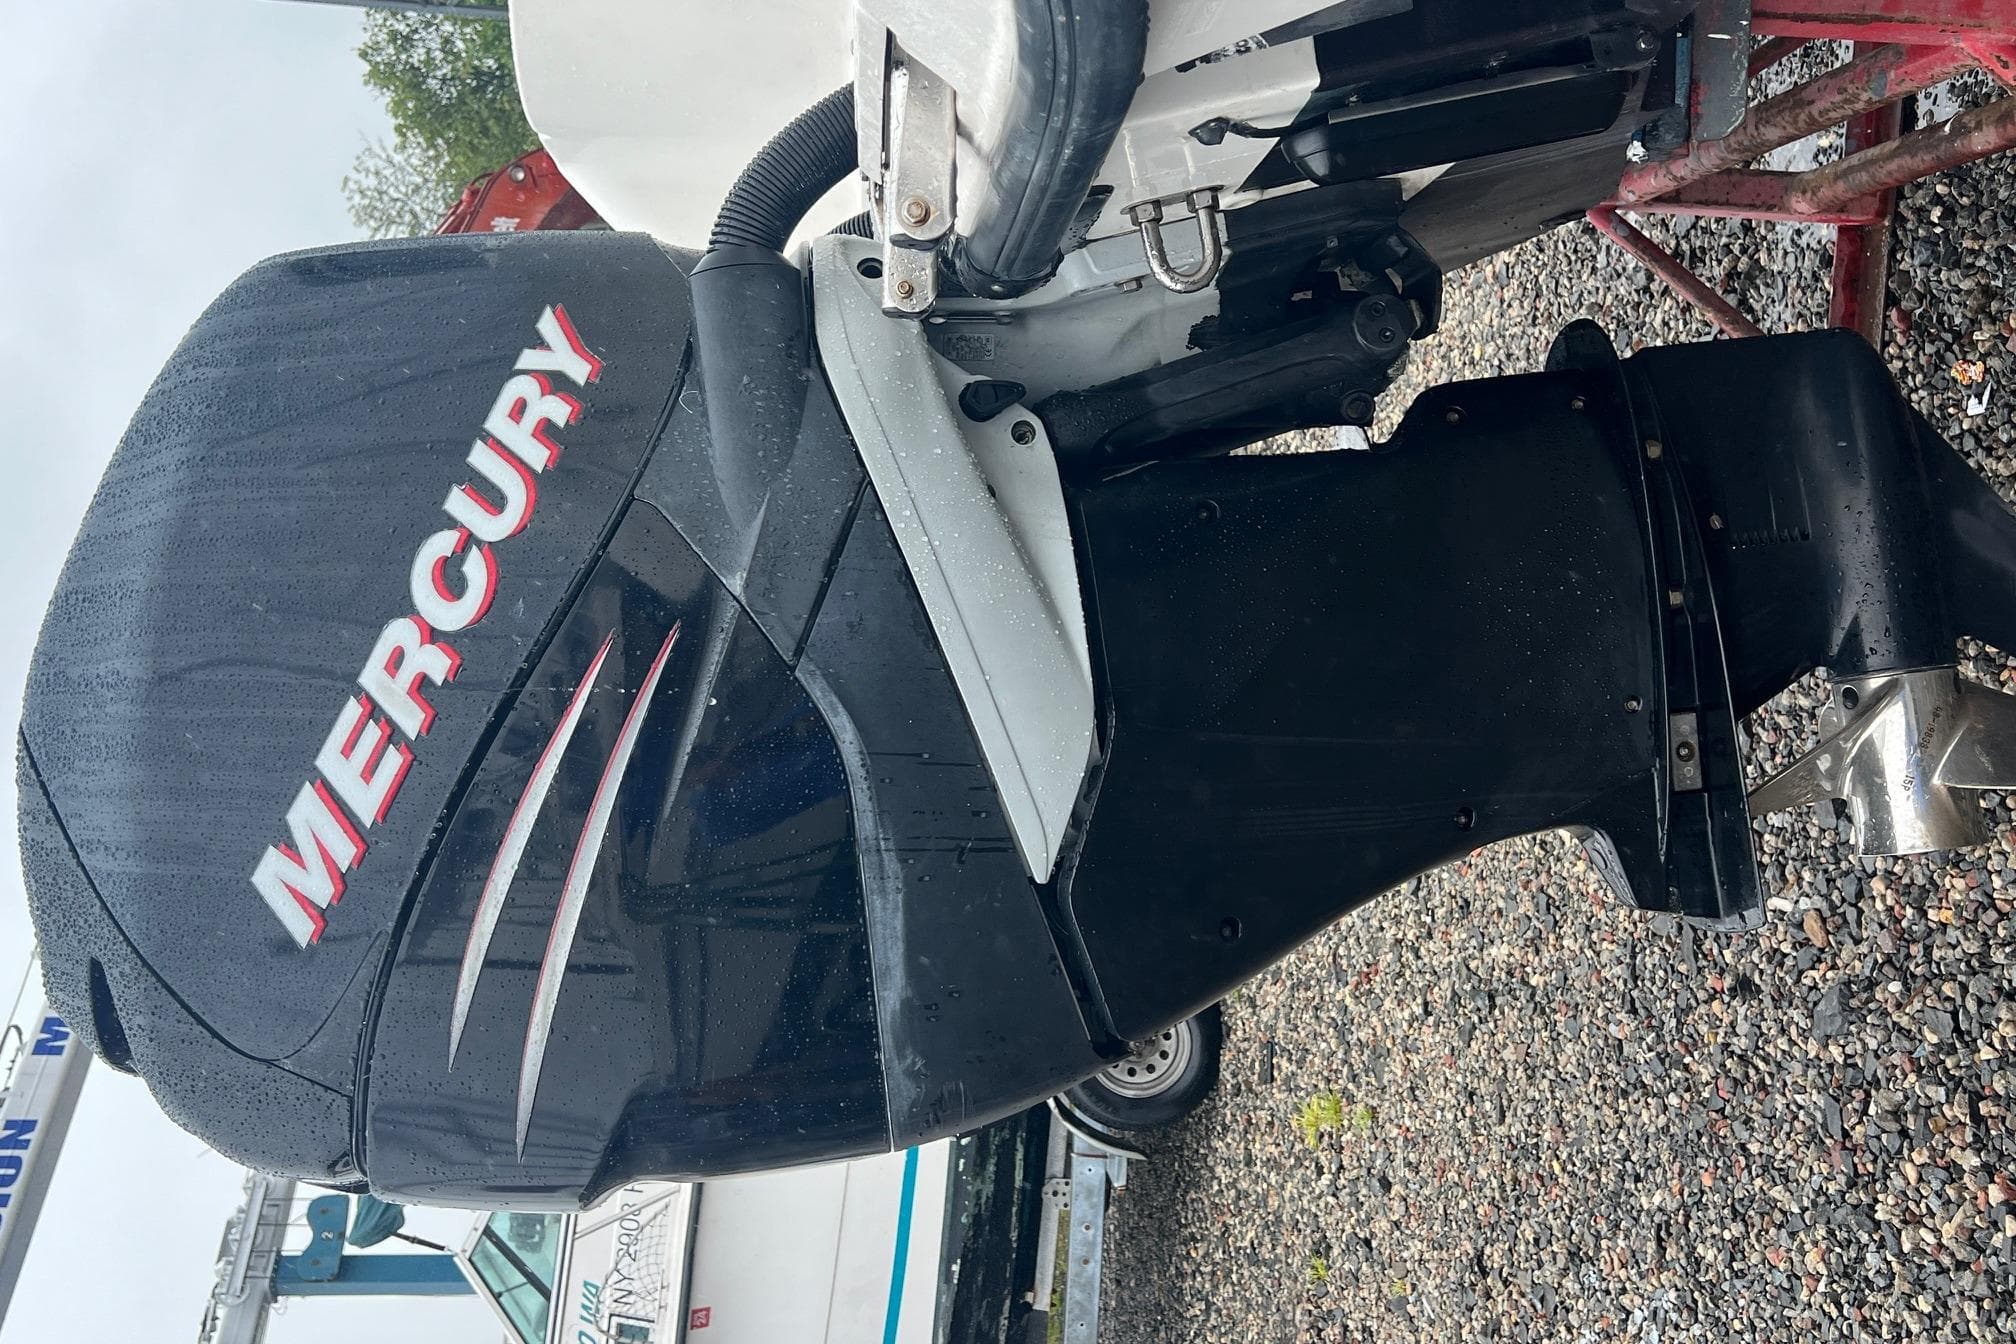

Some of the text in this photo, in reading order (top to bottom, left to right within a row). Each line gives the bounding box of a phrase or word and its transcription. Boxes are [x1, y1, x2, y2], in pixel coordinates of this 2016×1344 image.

[249, 303, 604, 949] MERCURY
[320, 1231, 334, 1240] 2
[617, 1203, 642, 1262] 2908
[613, 1267, 635, 1306] NY
